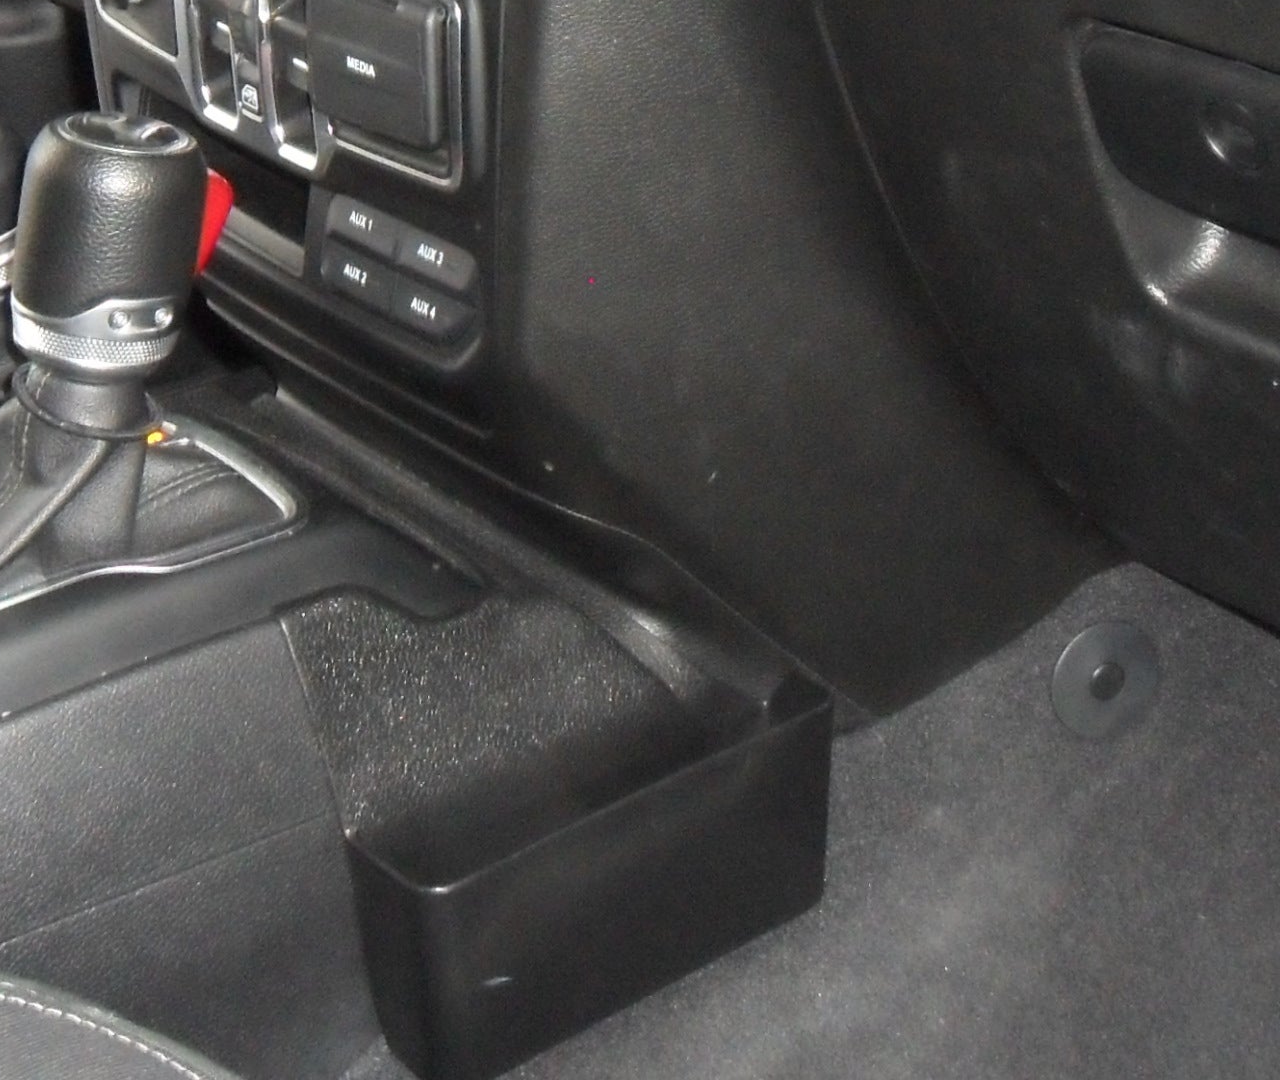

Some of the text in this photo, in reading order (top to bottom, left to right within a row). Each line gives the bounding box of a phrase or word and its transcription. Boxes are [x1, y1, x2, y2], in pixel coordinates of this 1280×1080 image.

[346, 55, 376, 79] MEDIA
[349, 210, 367, 229] AUX
[417, 243, 444, 267] AUX 3
[343, 263, 368, 286] AUX 2
[410, 296, 437, 320] AUX 4
